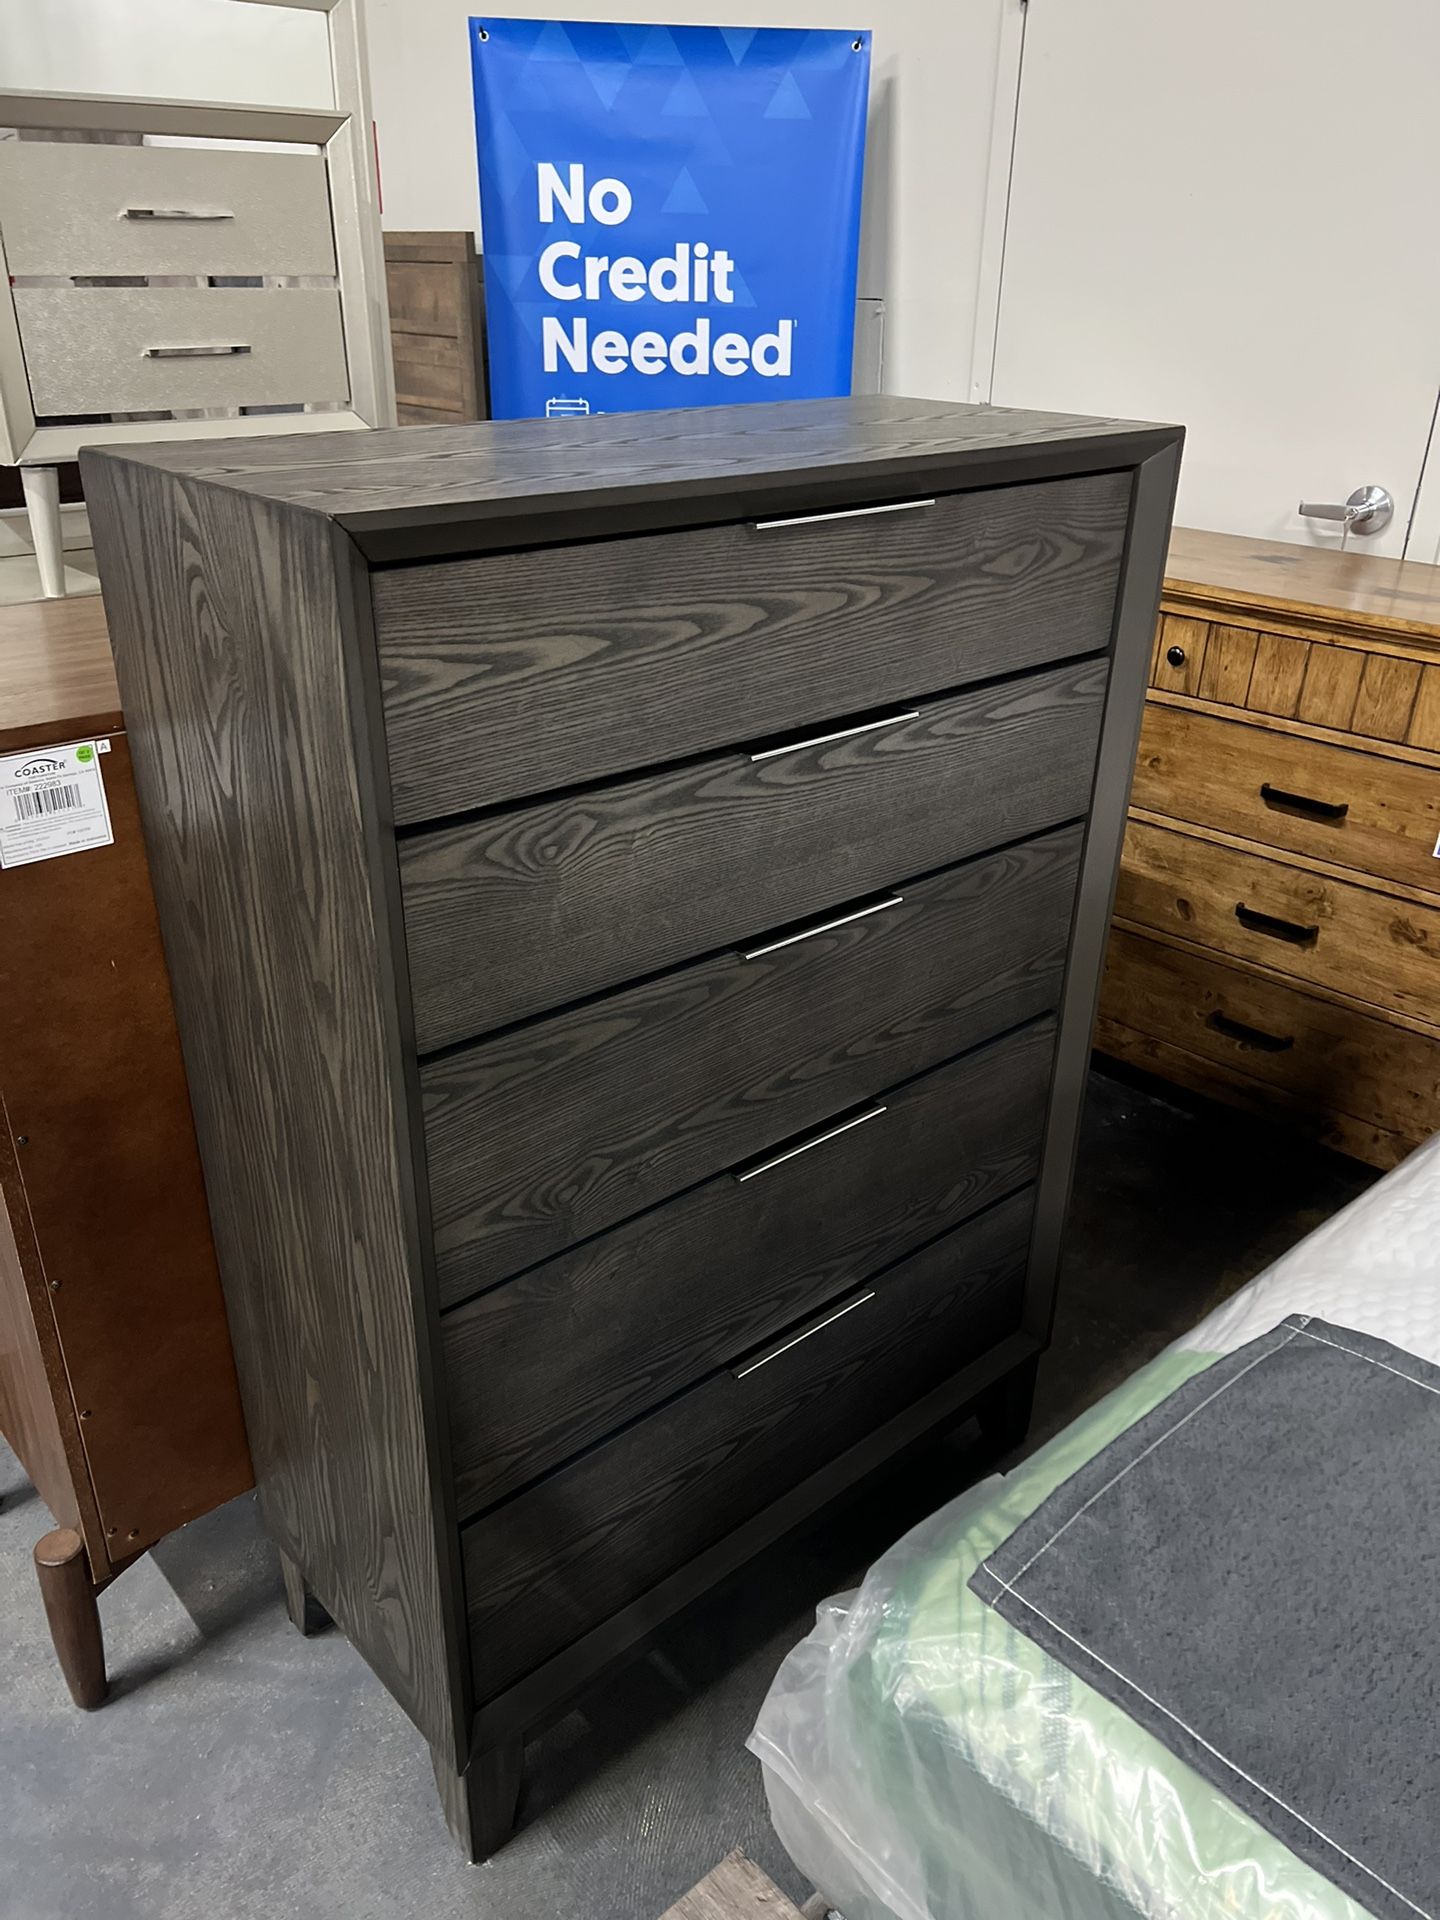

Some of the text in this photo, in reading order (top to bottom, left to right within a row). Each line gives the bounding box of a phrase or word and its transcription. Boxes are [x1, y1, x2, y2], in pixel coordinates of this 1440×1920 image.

[538, 163, 631, 225] No
[539, 241, 733, 303] Credit
[100, 742, 108, 751] A
[14, 761, 66, 778] COASTER
